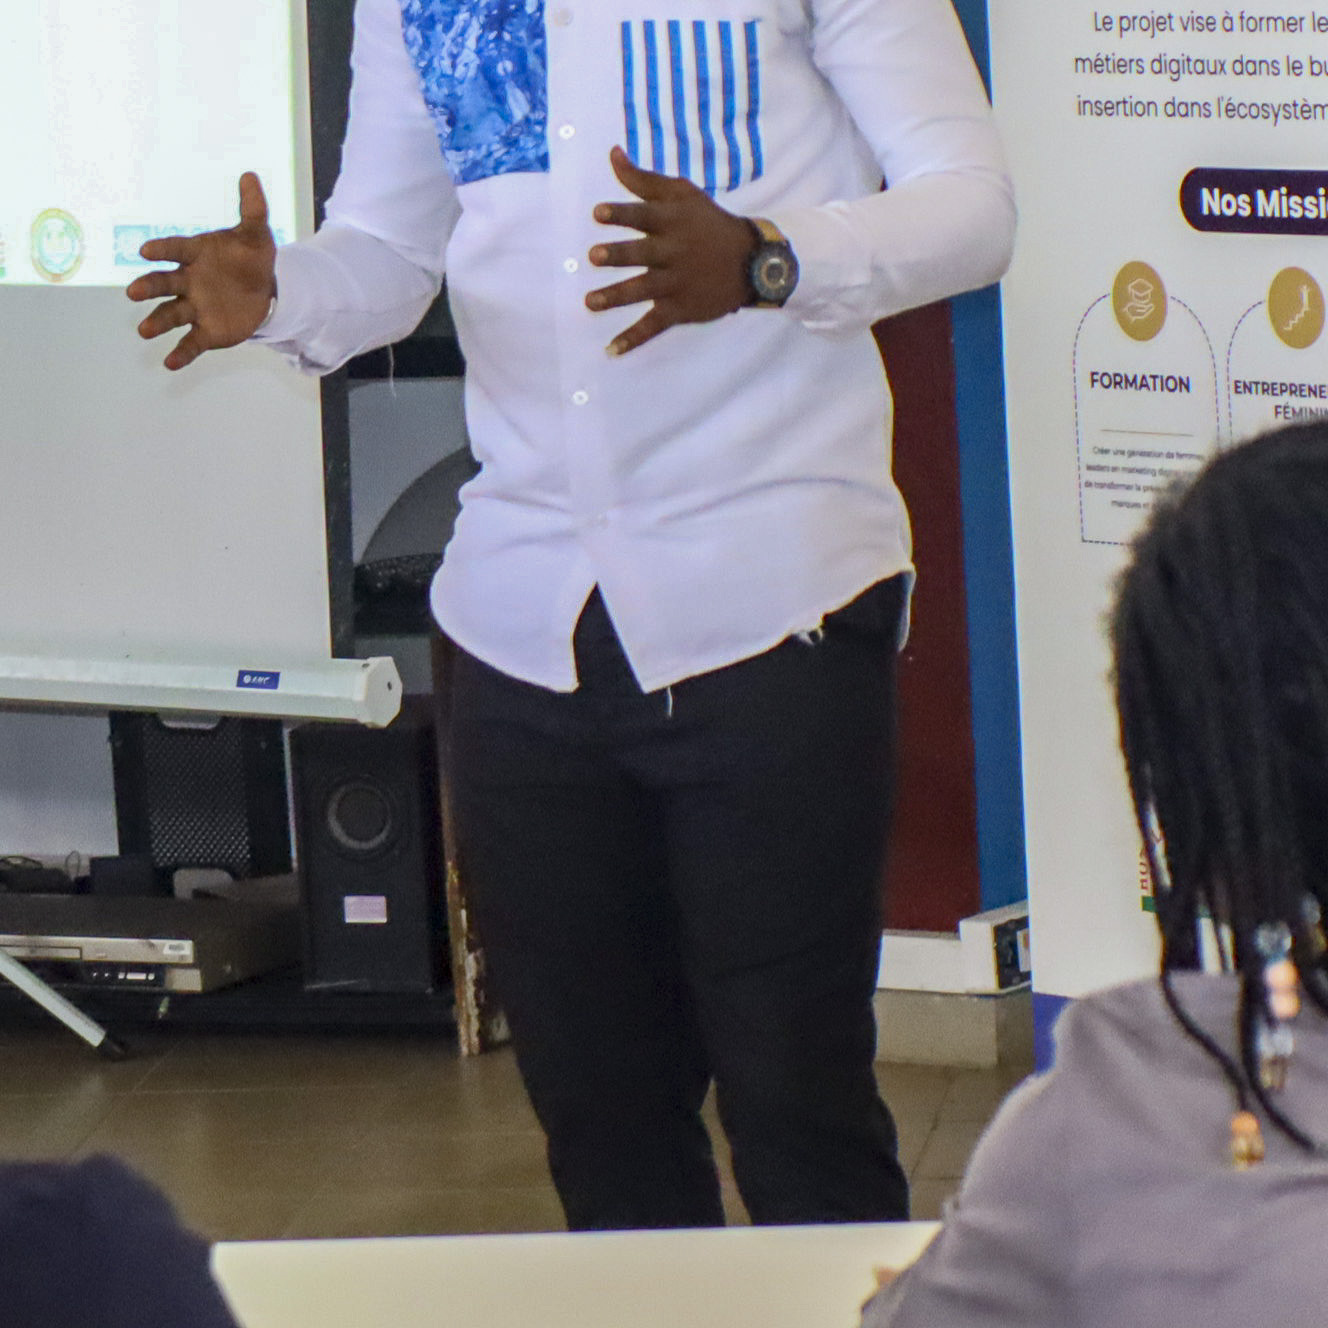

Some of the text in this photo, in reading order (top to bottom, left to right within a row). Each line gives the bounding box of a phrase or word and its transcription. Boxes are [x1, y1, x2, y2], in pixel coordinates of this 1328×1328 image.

[1094, 11, 1114, 32] Le
[1118, 11, 1175, 39] projet
[1181, 11, 1217, 33] vise
[1223, 10, 1234, 33] à
[1238, 10, 1306, 33] former
[1074, 54, 1145, 76] métiers
[1150, 53, 1227, 80] digitaux
[1232, 54, 1280, 77] dans
[1285, 54, 1304, 77] le
[1077, 95, 1158, 118] insertion
[1163, 96, 1212, 119] dans
[1201, 188, 1252, 217] Nos
[1089, 371, 1192, 394] FORMATION
